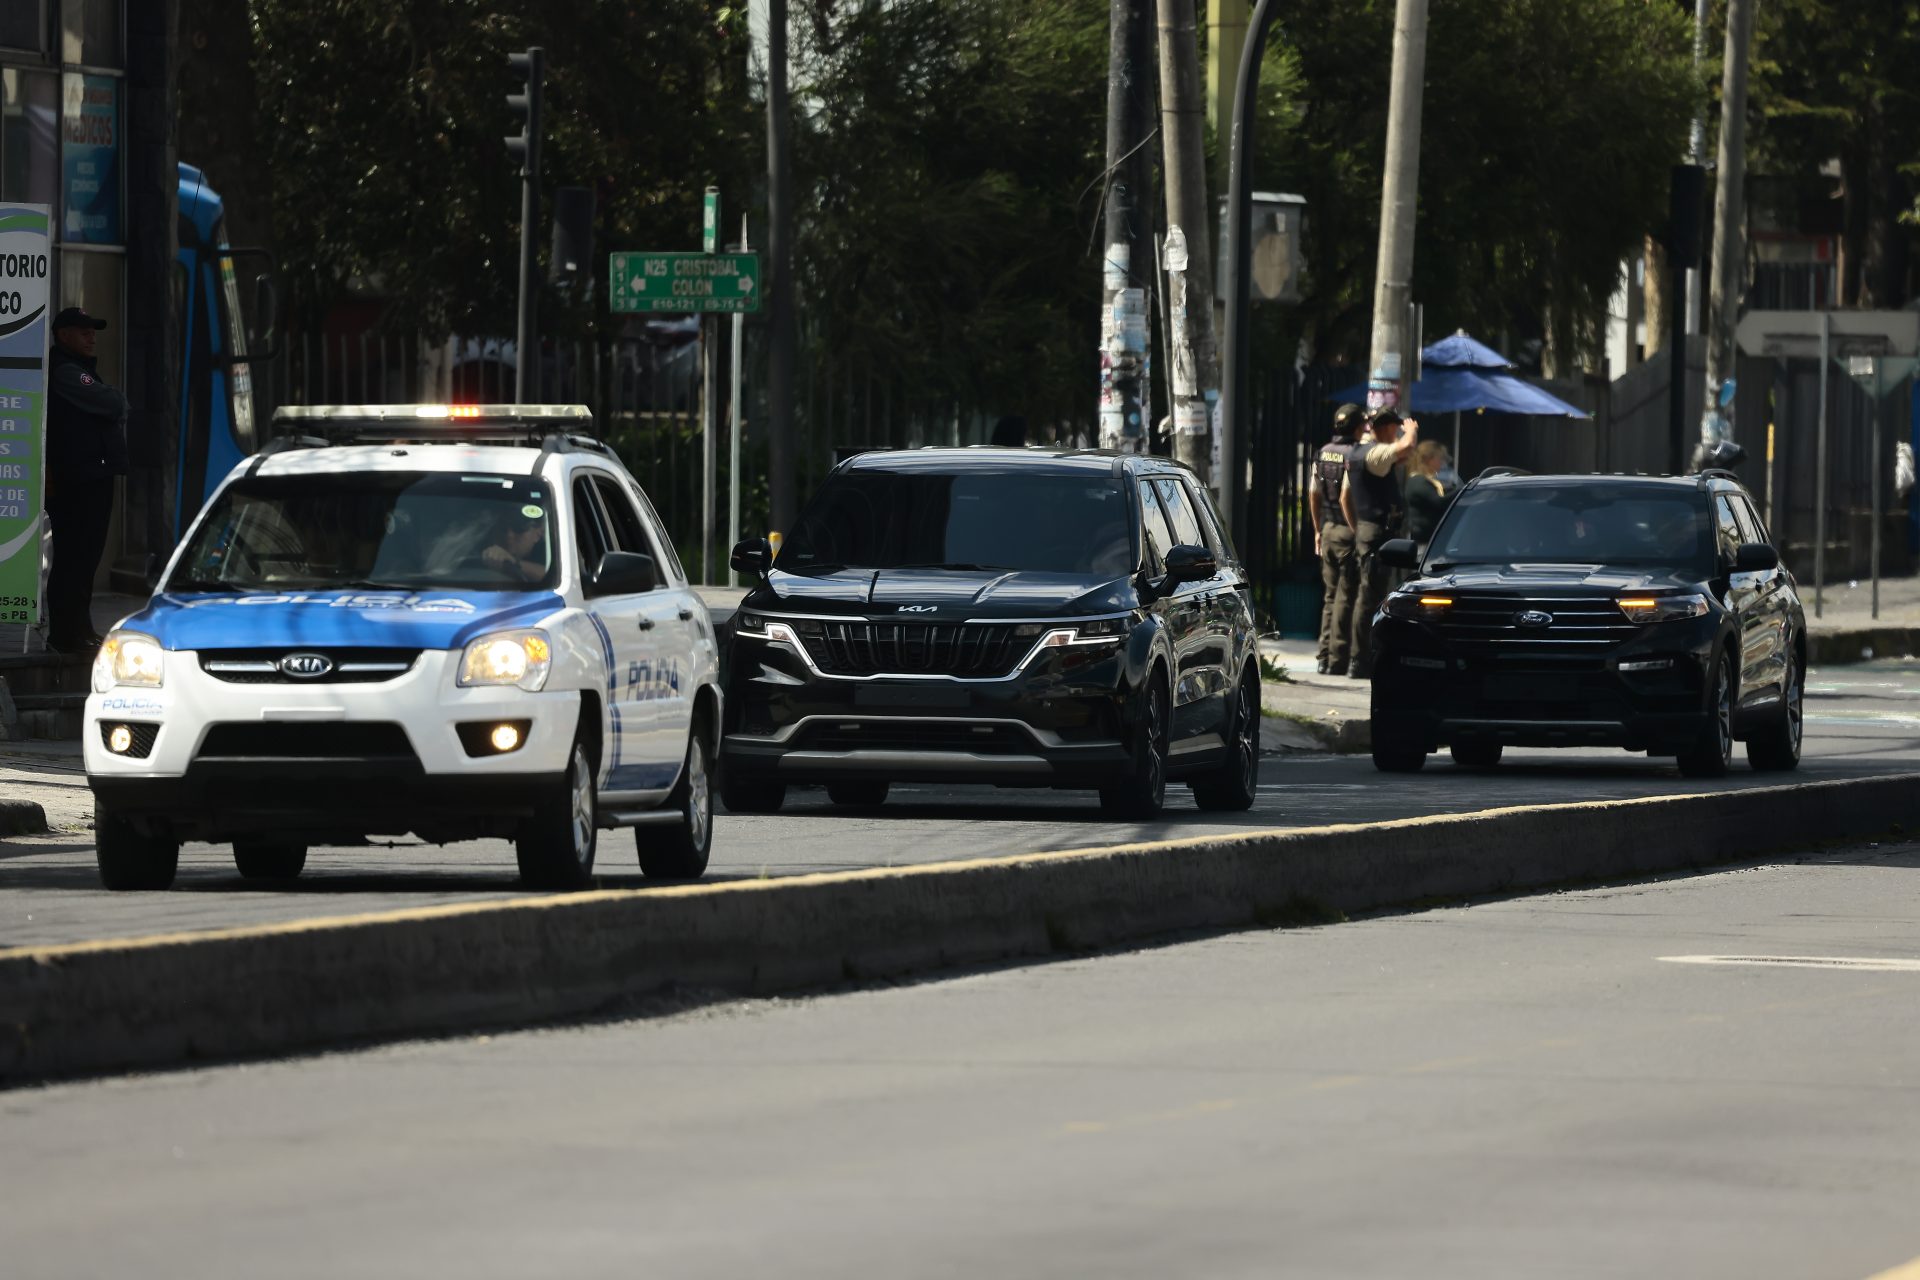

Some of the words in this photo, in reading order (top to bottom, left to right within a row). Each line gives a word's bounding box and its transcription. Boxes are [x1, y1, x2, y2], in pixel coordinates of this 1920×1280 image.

[644, 259, 668, 276] N25
[674, 259, 740, 276] CRISTOBAL
[291, 658, 323, 672] KIA
